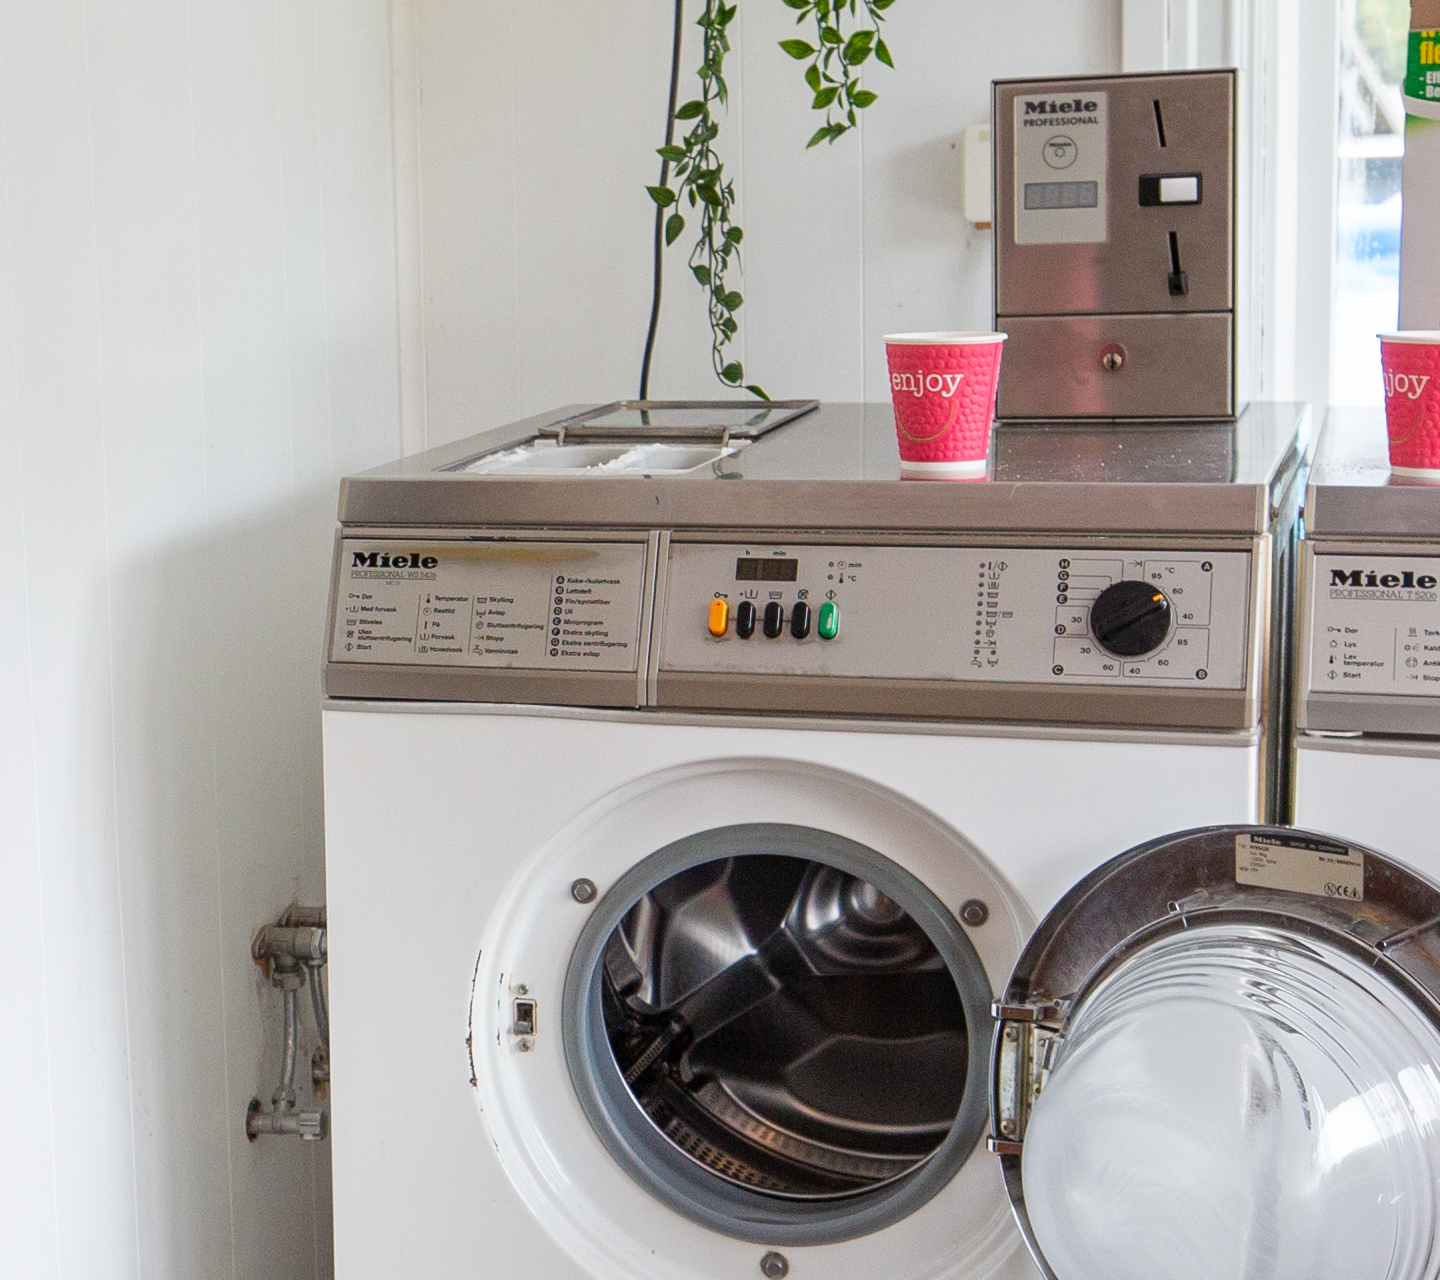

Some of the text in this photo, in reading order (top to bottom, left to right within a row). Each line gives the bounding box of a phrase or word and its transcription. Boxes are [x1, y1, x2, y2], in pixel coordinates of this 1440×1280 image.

[1024, 99, 1098, 114] Miele
[1024, 117, 1098, 126] PROFESSIONAL
[892, 370, 964, 398] enjoy
[352, 552, 438, 569] Miele
[351, 570, 404, 578] PROFESSIONAL
[1151, 572, 1162, 580] 95
[1330, 570, 1438, 589] Miele
[1330, 590, 1437, 599] PROFESSIONAL T 5206
[1182, 612, 1194, 620] 40
[1177, 638, 1188, 646] 95
[1080, 646, 1091, 654] 30
[1254, 836, 1281, 845] Miele
[1336, 886, 1348, 896] CE
